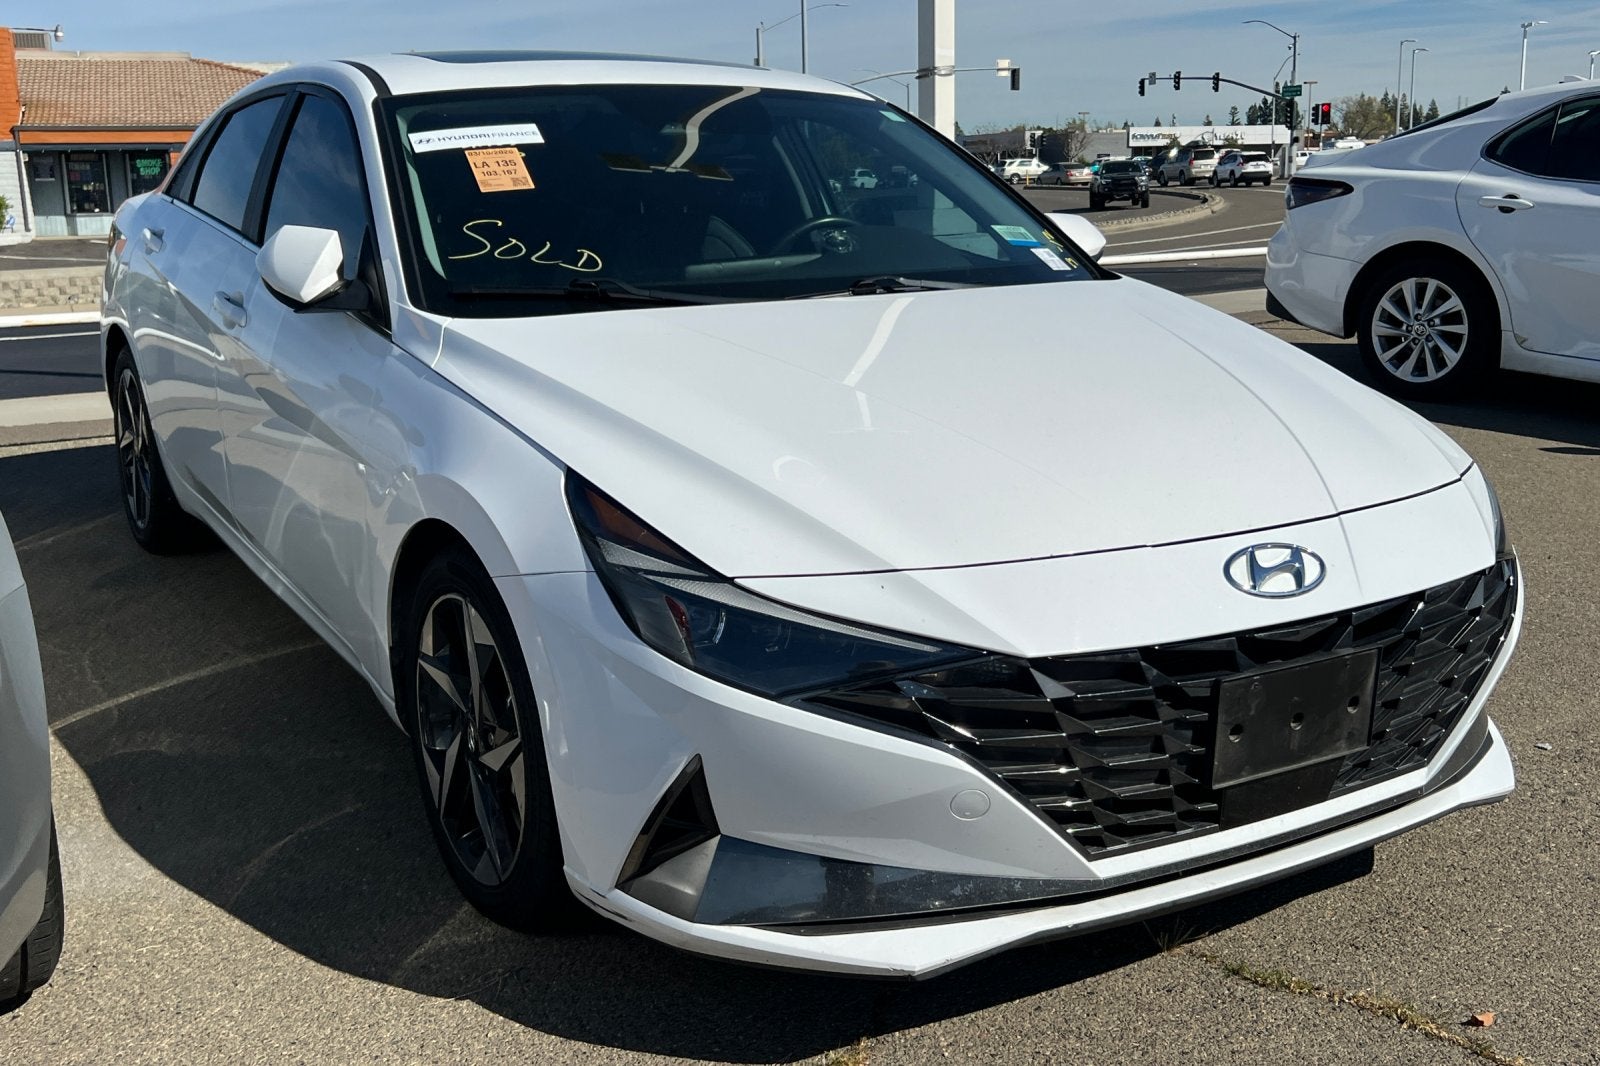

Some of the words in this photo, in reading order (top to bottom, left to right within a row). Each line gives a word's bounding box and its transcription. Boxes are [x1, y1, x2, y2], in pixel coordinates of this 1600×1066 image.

[437, 133, 490, 142] HYUNDAI
[491, 130, 539, 138] FINANCE
[136, 159, 162, 167] SMOKE
[473, 161, 490, 169] LA
[495, 159, 517, 167] 135
[139, 167, 161, 175] SHOP
[448, 219, 603, 272] SOLD
